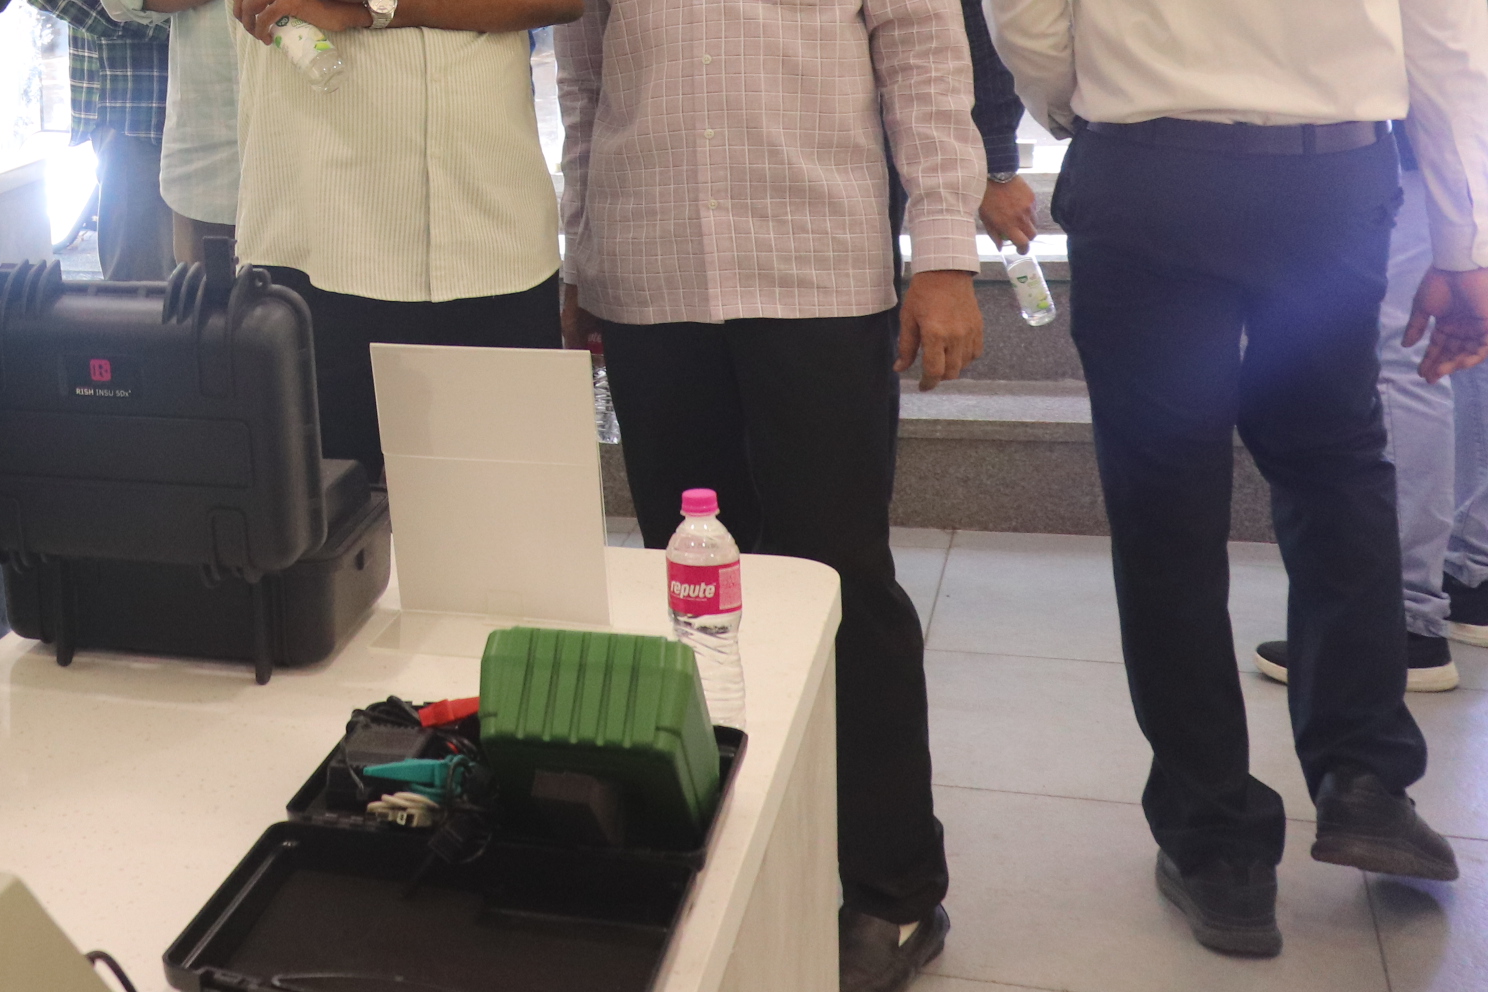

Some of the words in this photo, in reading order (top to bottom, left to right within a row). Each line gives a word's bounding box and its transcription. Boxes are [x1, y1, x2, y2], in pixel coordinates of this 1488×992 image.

[75, 387, 94, 396] RISH
[96, 388, 114, 397] INSU
[670, 580, 716, 599] repute
